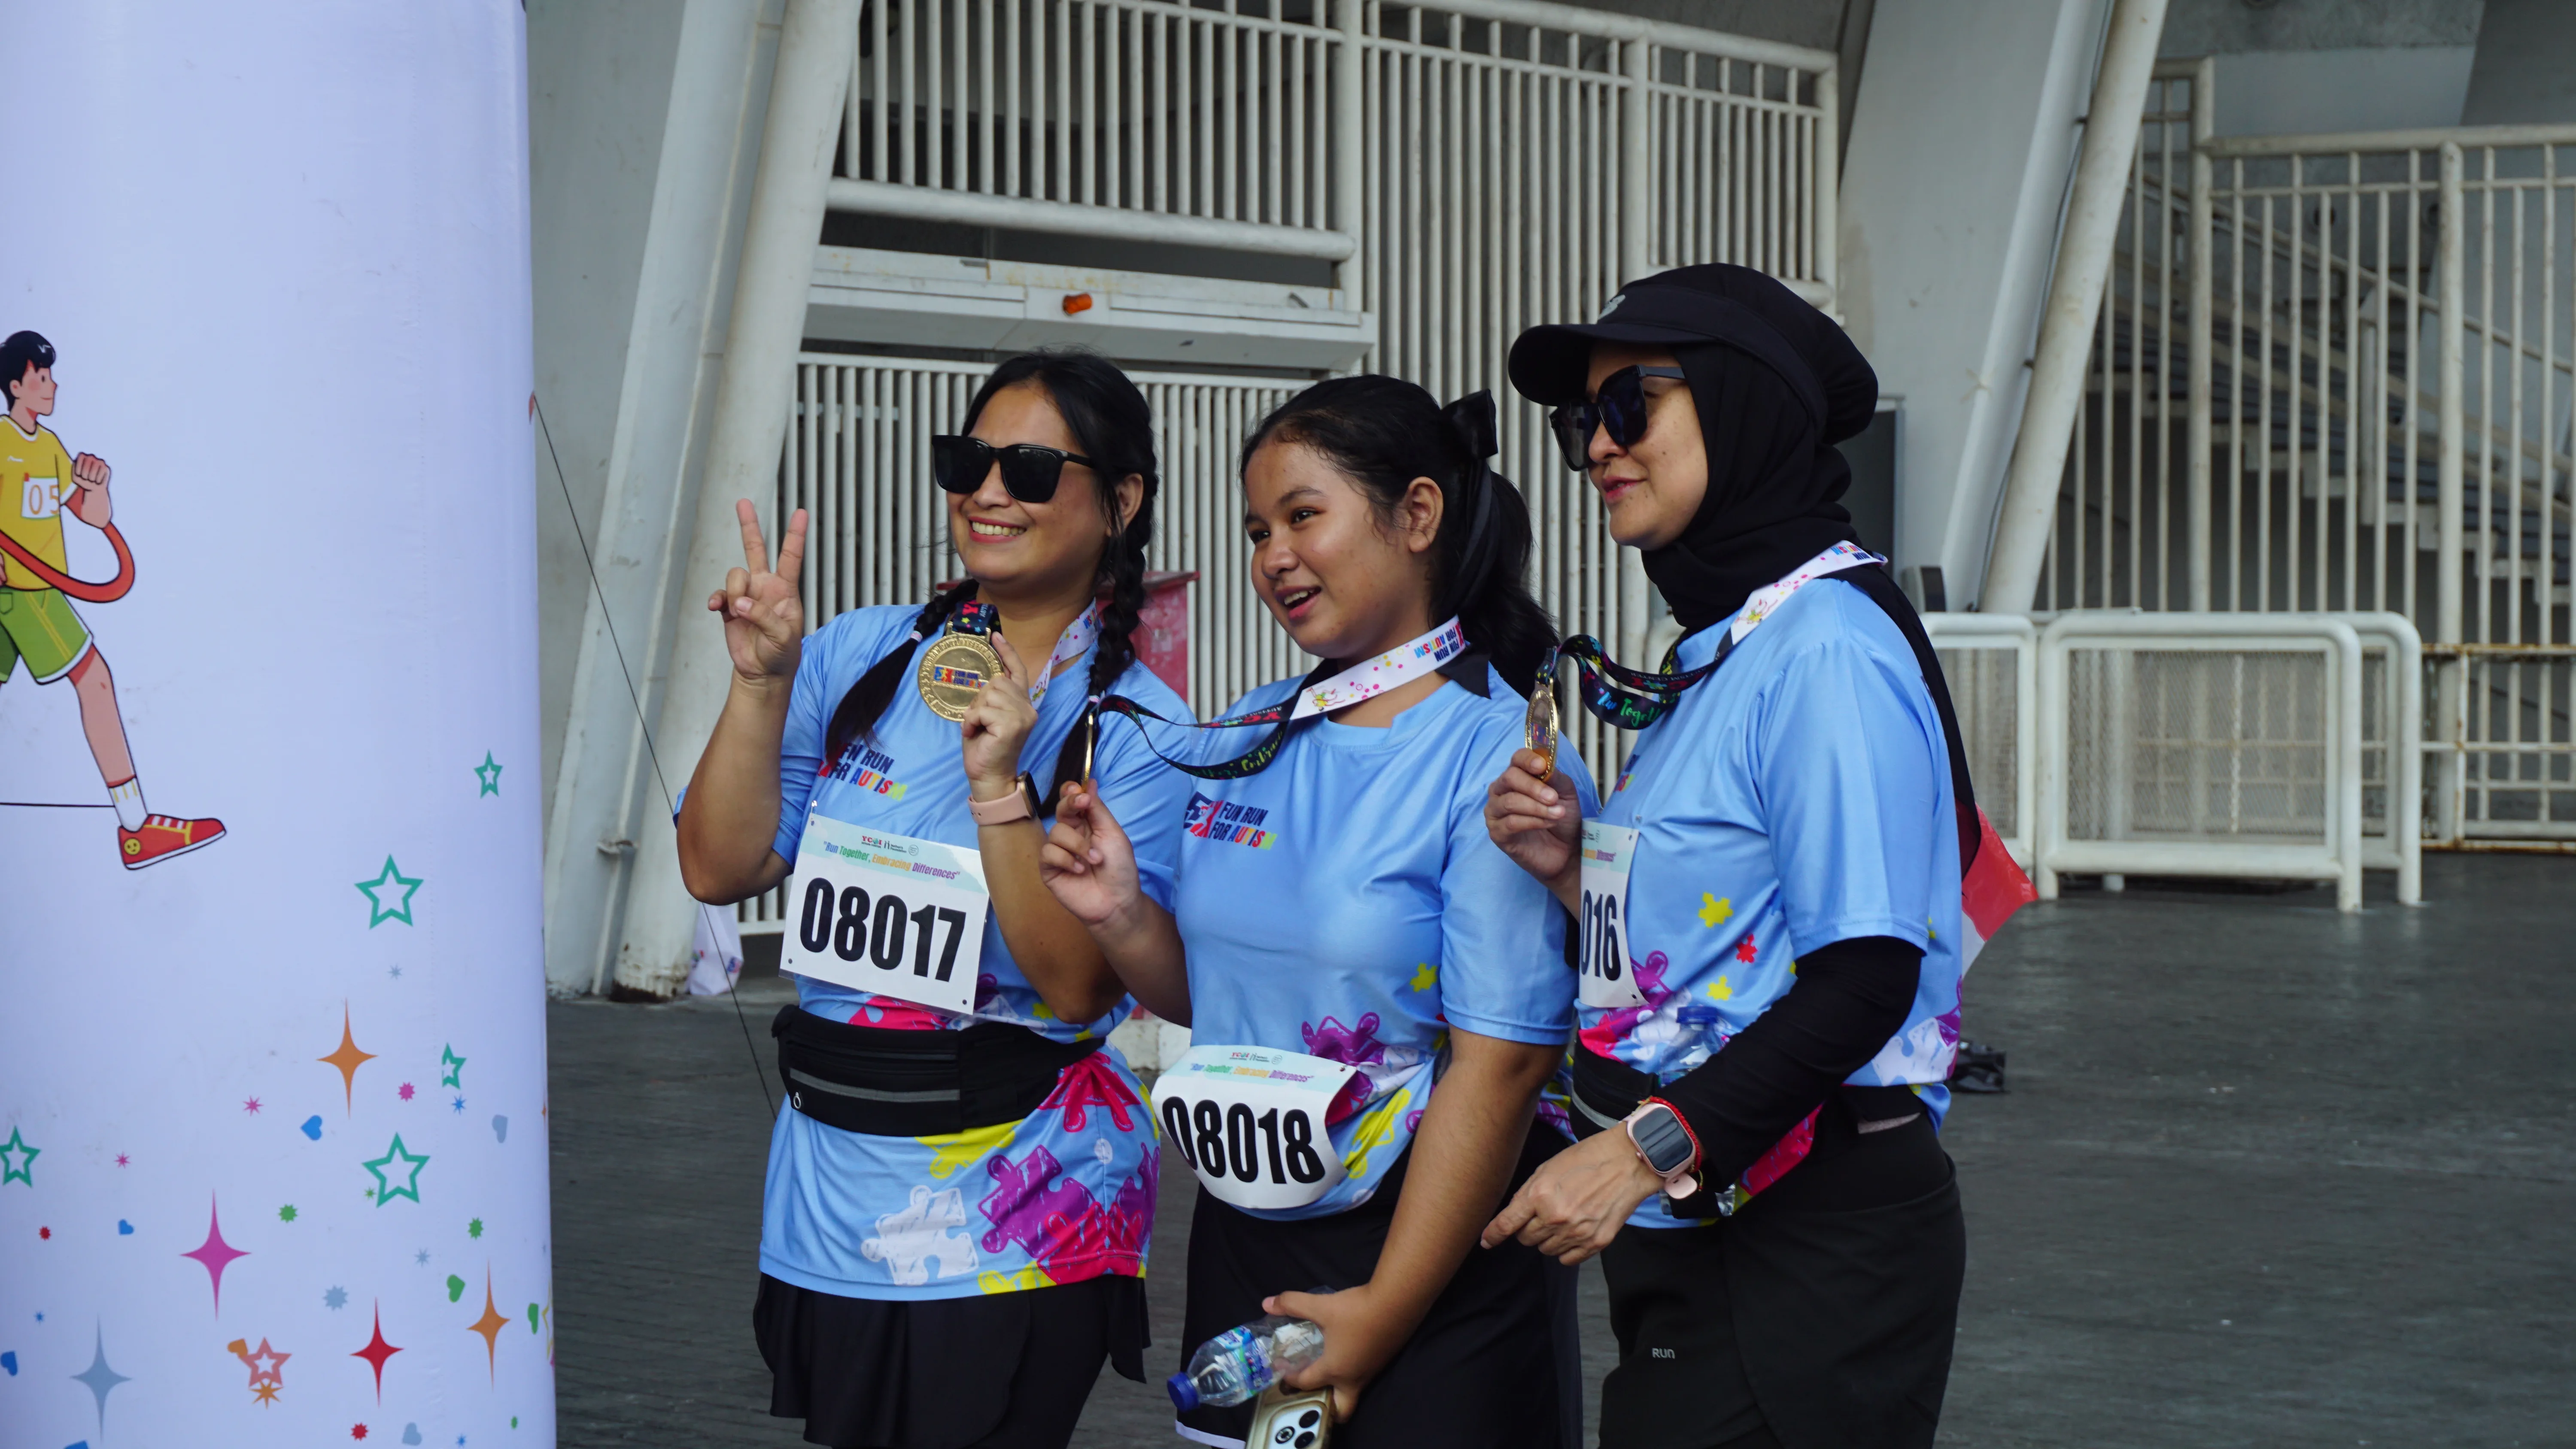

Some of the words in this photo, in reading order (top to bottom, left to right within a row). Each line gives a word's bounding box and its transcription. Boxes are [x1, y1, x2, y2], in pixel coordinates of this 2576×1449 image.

[28, 484, 59, 515] 05
[1414, 634, 1446, 658] AUTISM
[1445, 626, 1456, 641] FOR
[1449, 638, 1460, 653] FUN
[1434, 646, 1450, 662] RUN
[860, 749, 895, 774] RUN
[849, 767, 908, 802] AUTISM
[1218, 801, 1245, 822] FUN
[1239, 806, 1269, 827] RUN
[1208, 821, 1232, 841] FOR
[1227, 825, 1278, 851] AUTISM
[872, 853, 912, 871] Embracing
[800, 877, 966, 982] 08017
[1162, 1096, 1325, 1185] 08018
